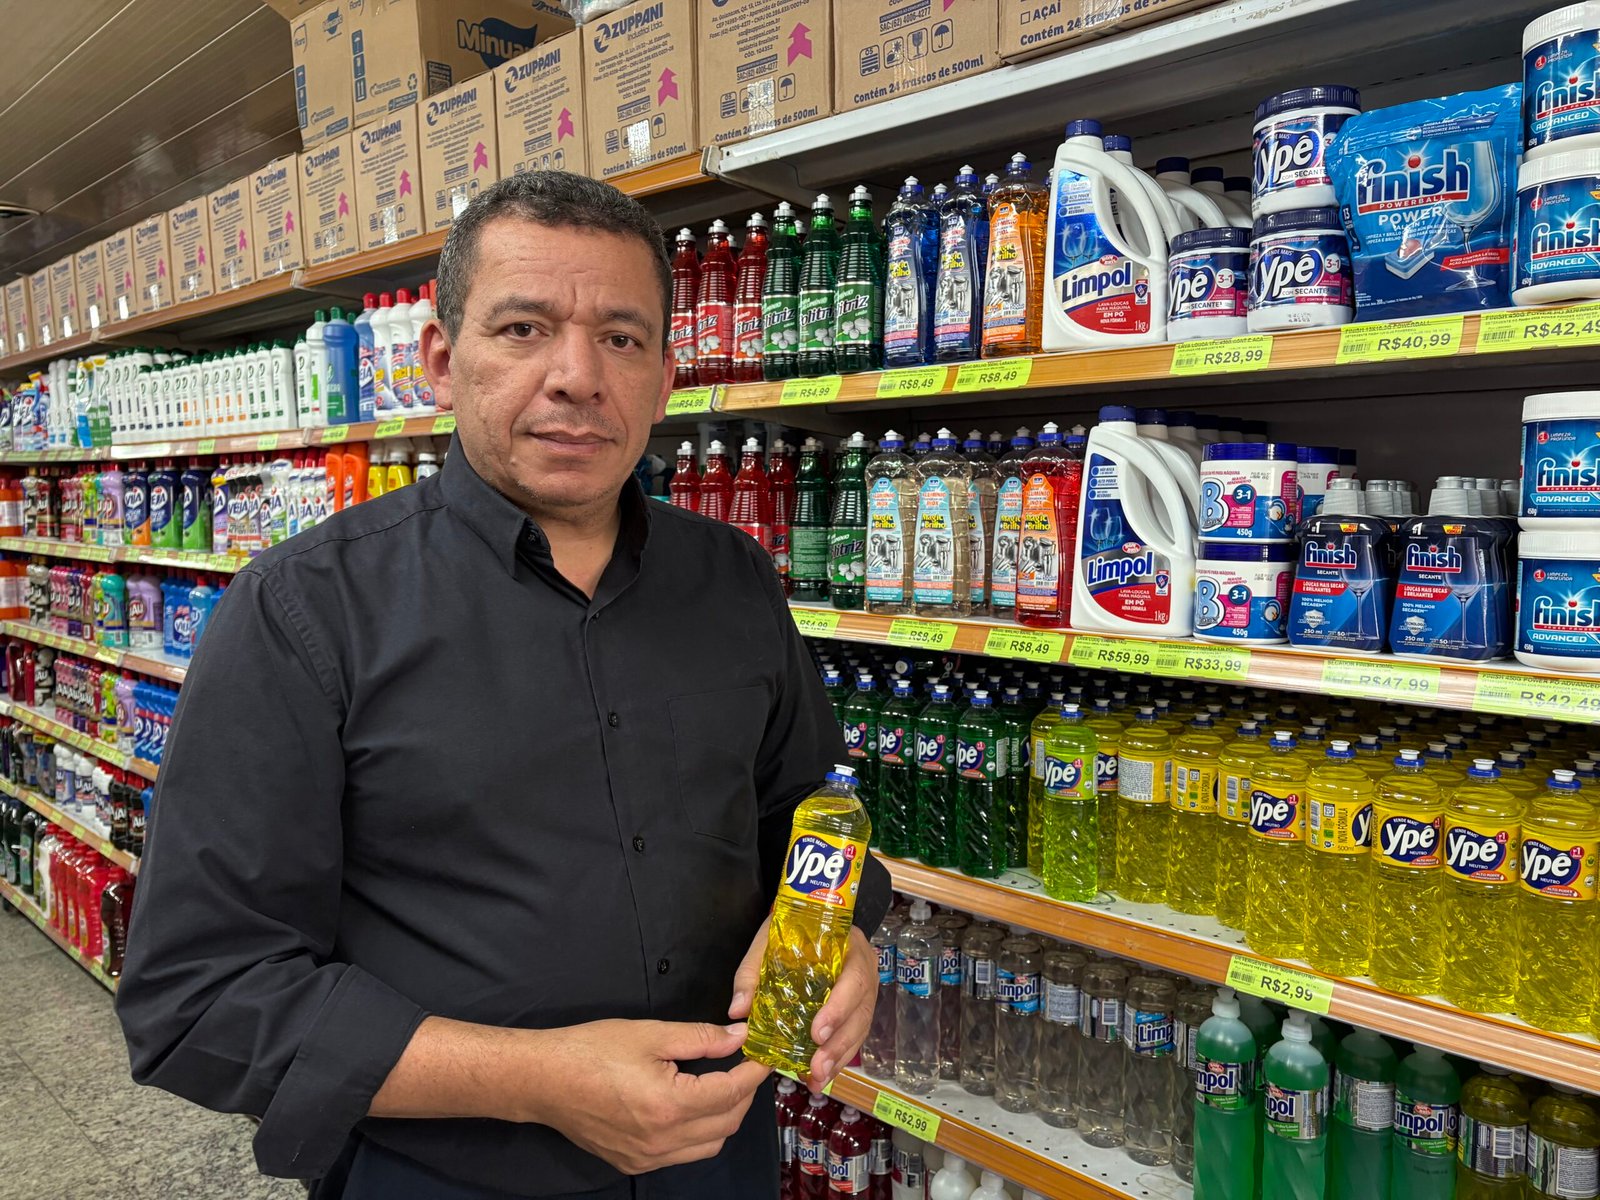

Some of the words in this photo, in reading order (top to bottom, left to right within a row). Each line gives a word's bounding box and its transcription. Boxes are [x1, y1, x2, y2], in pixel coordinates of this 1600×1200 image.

[612, 2, 664, 39] ZUPPANI
[1021, 26, 1064, 45] Contém
[1067, 18, 1082, 29] 24
[457, 19, 531, 60] Minua
[519, 48, 561, 81] ZUPPANI
[854, 88, 887, 103] Contém
[889, 83, 900, 93] 24
[902, 73, 936, 90] frascos
[939, 67, 950, 78] de
[952, 55, 984, 74] 500ml
[440, 88, 477, 114] ZUPPANI
[715, 129, 742, 142] Contém
[783, 114, 792, 124] de
[794, 106, 818, 121] 500ml
[1536, 111, 1589, 131] ADVANCED
[603, 163, 625, 176] Contém
[658, 149, 665, 159] de
[666, 143, 687, 157] 500ml
[1358, 149, 1470, 206] finish
[1380, 195, 1445, 209] POWERBALL
[1379, 206, 1442, 226] POWER
[1531, 257, 1585, 270] ADVANCED
[1062, 261, 1132, 303] Limpol
[801, 306, 835, 327] olitri
[1378, 333, 1451, 351] R$40,99
[1204, 350, 1263, 366] R$28,99
[899, 378, 934, 391] R$8,49
[978, 371, 1017, 384] R$8,49
[800, 388, 830, 399] R$4,99
[1536, 495, 1590, 503] ADVANCED
[1236, 529, 1253, 538] 450g
[1412, 522, 1423, 535] #1
[1305, 541, 1357, 565] finish
[1406, 543, 1462, 570] finish
[1087, 551, 1153, 586] Limpol
[1135, 599, 1145, 607] PÓ
[910, 631, 943, 643] R$8,49
[1232, 628, 1248, 638] 450g
[1533, 634, 1587, 643] ADVANCED
[1010, 641, 1050, 655] R$8,49
[1098, 650, 1150, 665] R$59,99
[1184, 657, 1242, 672] R$33,99
[880, 730, 896, 753] pê
[918, 737, 938, 760] pê
[958, 743, 978, 767] pê
[1044, 761, 1076, 788] Ypê
[1098, 757, 1118, 776] pê
[1249, 796, 1289, 827] Ypê
[815, 839, 828, 848] MAIS
[1382, 823, 1435, 860] Ypê
[1447, 833, 1499, 867] Ypê
[784, 843, 845, 885] Ypê
[1521, 846, 1572, 881] Ypê
[810, 879, 830, 888] NEUTRO
[1261, 975, 1313, 1002] R$2,99
[1139, 1024, 1173, 1043] Limp
[1197, 1070, 1234, 1092] mpol
[894, 1109, 928, 1131] R$2,99
[1396, 1105, 1443, 1135] impol
